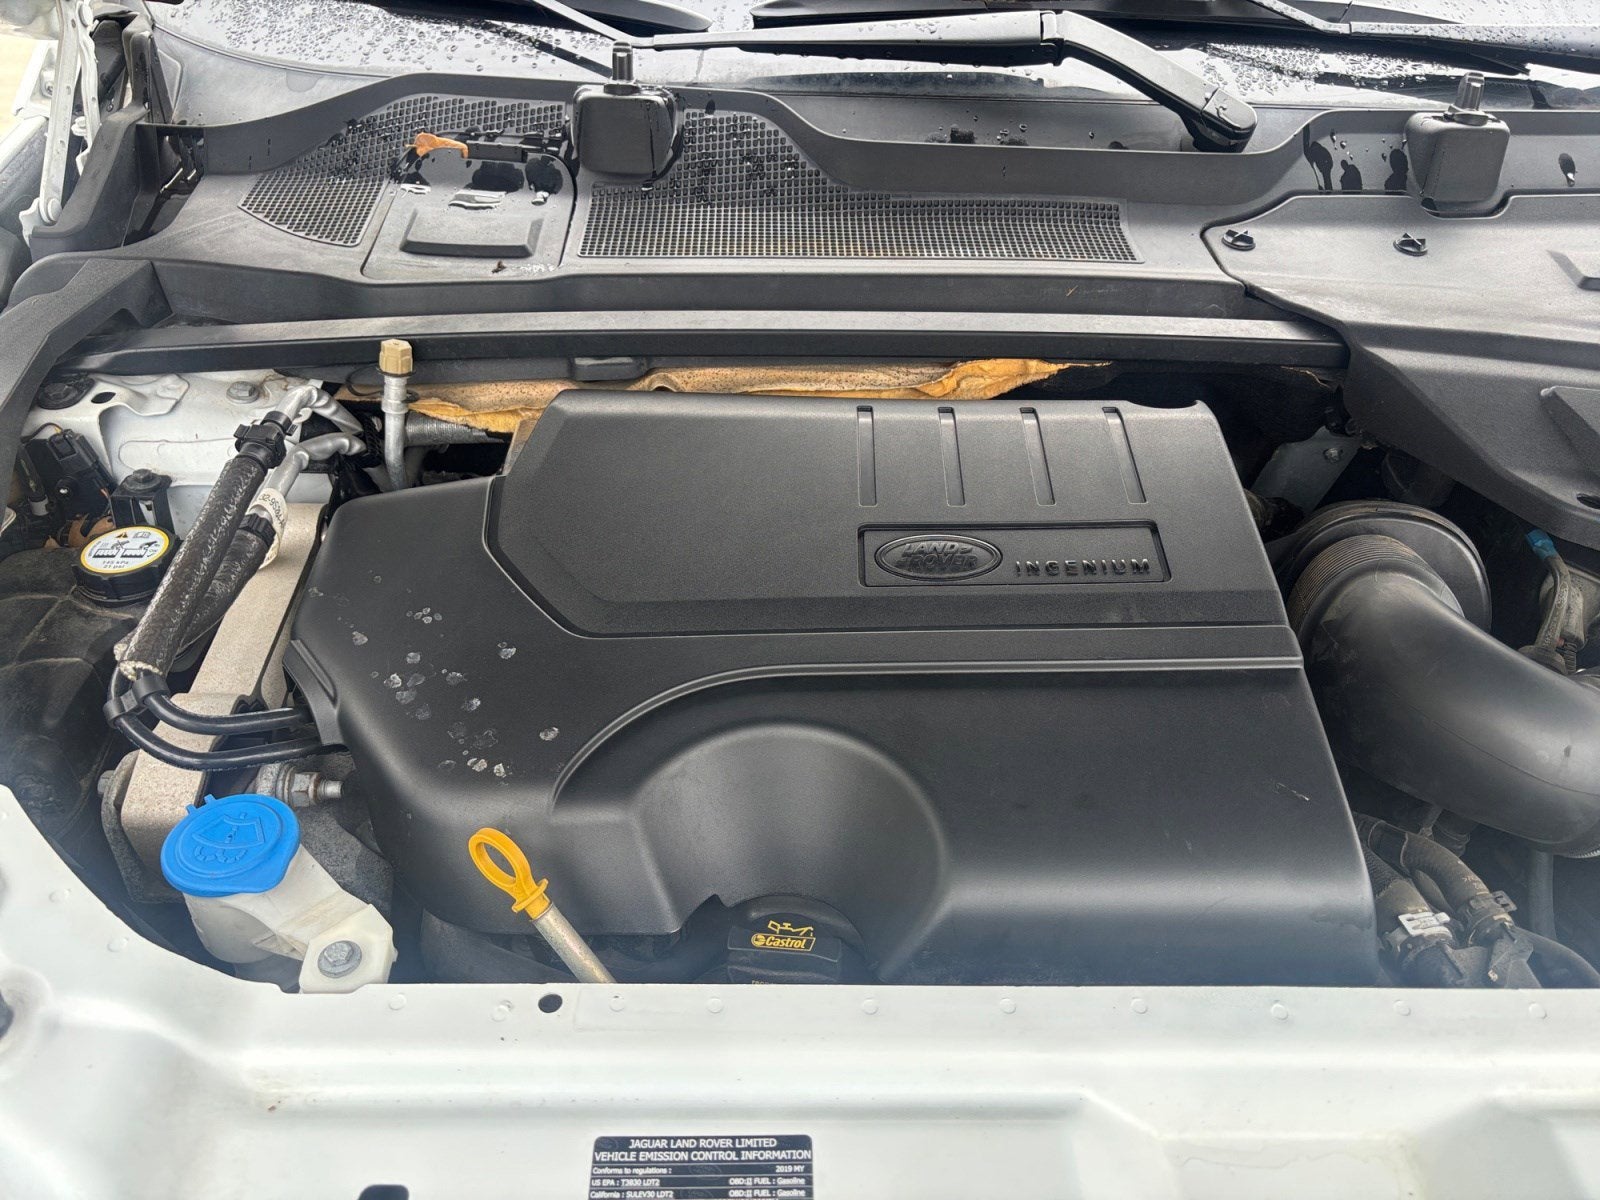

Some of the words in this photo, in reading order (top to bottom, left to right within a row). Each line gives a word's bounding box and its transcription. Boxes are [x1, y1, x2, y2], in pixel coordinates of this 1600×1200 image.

[902, 542, 967, 557] LAND
[909, 554, 979, 571] ROVER
[1015, 559, 1150, 577] INGENIUM
[765, 935, 806, 949] Castrol
[629, 1139, 668, 1149] JAGUAR
[670, 1139, 697, 1149] LAND
[699, 1138, 733, 1148] ROVER
[735, 1138, 777, 1148] LIMITED
[594, 1151, 637, 1161] VEHICLE
[639, 1151, 688, 1161] EMISSION
[690, 1151, 739, 1160] CONTROL
[740, 1149, 811, 1160] INFORMATION
[633, 1167, 667, 1175] regulations
[775, 1165, 793, 1173] 2019
[793, 1165, 805, 1173] MY
[753, 1177, 771, 1185] FUEL
[777, 1176, 805, 1185] Gasoline
[590, 1190, 620, 1198] California
[656, 1190, 674, 1198] LDT2
[753, 1189, 771, 1197] FUEL
[777, 1189, 805, 1197] Gasoline
